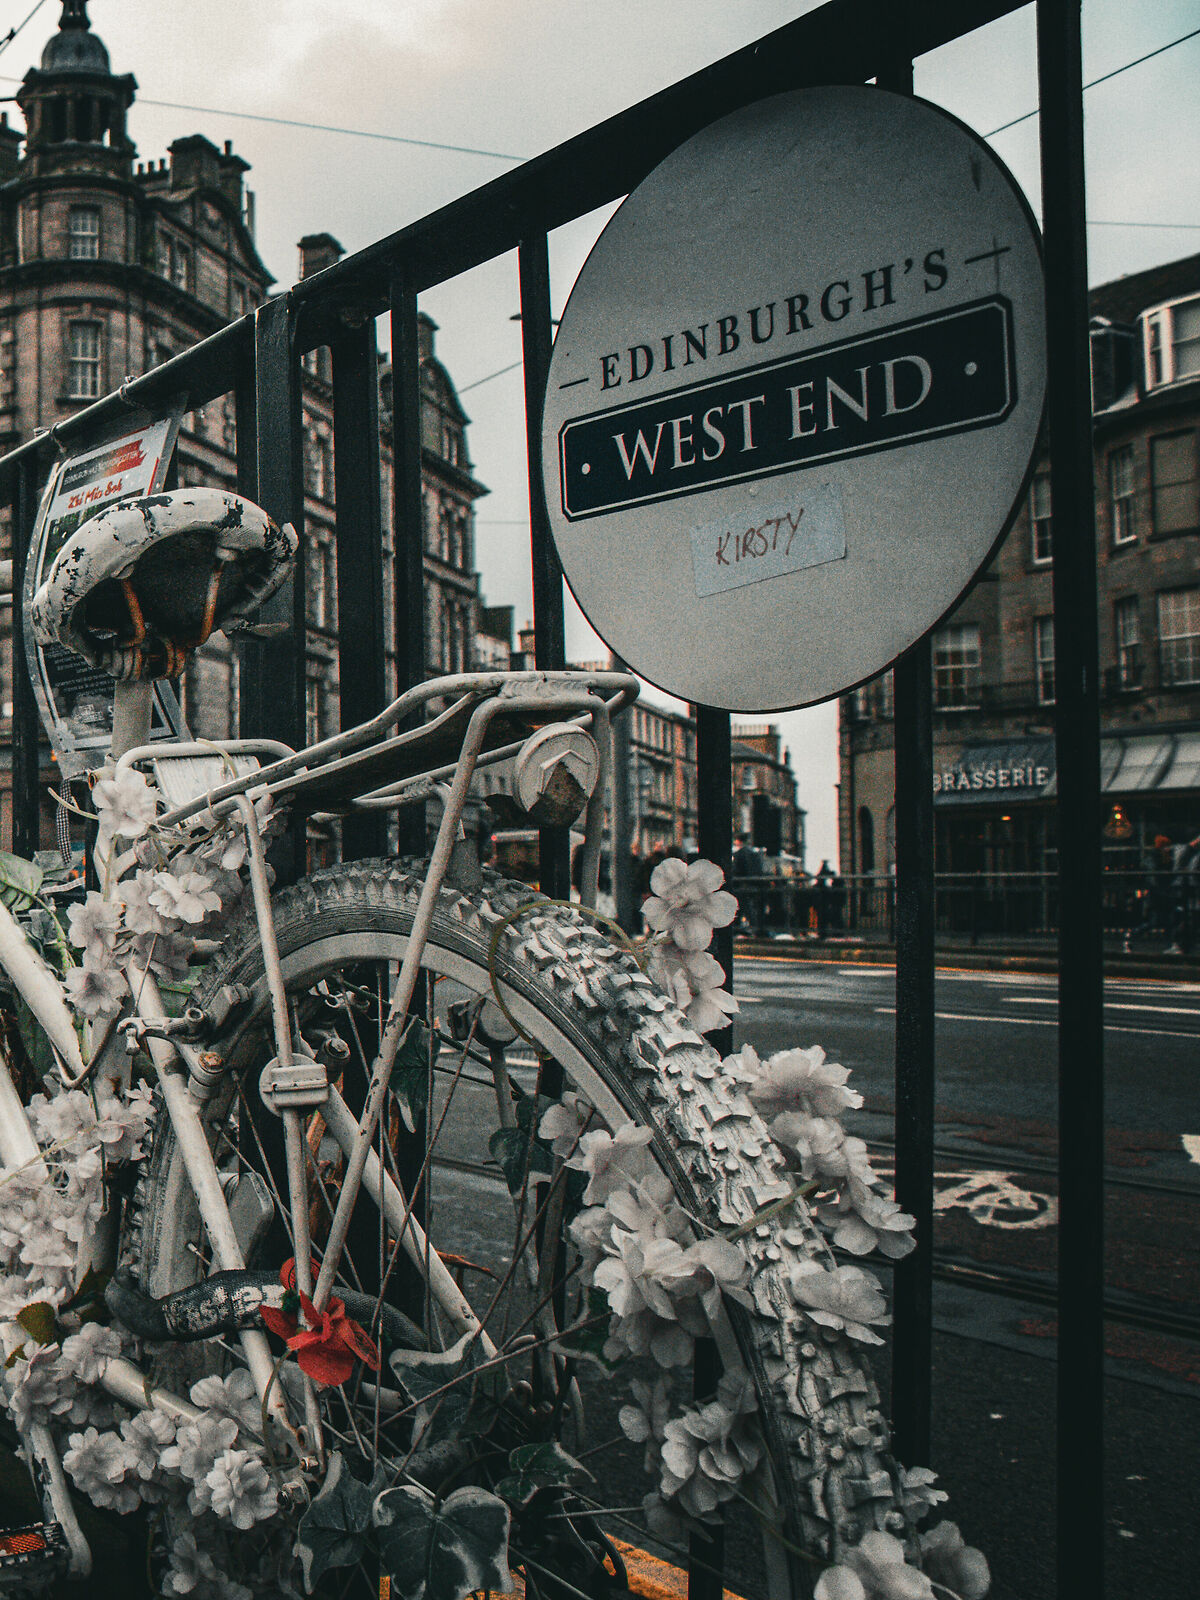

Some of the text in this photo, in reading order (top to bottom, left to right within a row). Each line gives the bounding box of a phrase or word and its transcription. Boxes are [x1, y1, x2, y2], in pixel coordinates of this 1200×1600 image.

[599, 248, 949, 391] EDINBURGH'S
[610, 354, 933, 481] WEST END
[715, 507, 805, 566] KIRSTY
[932, 766, 1050, 792] BRASSERIE
